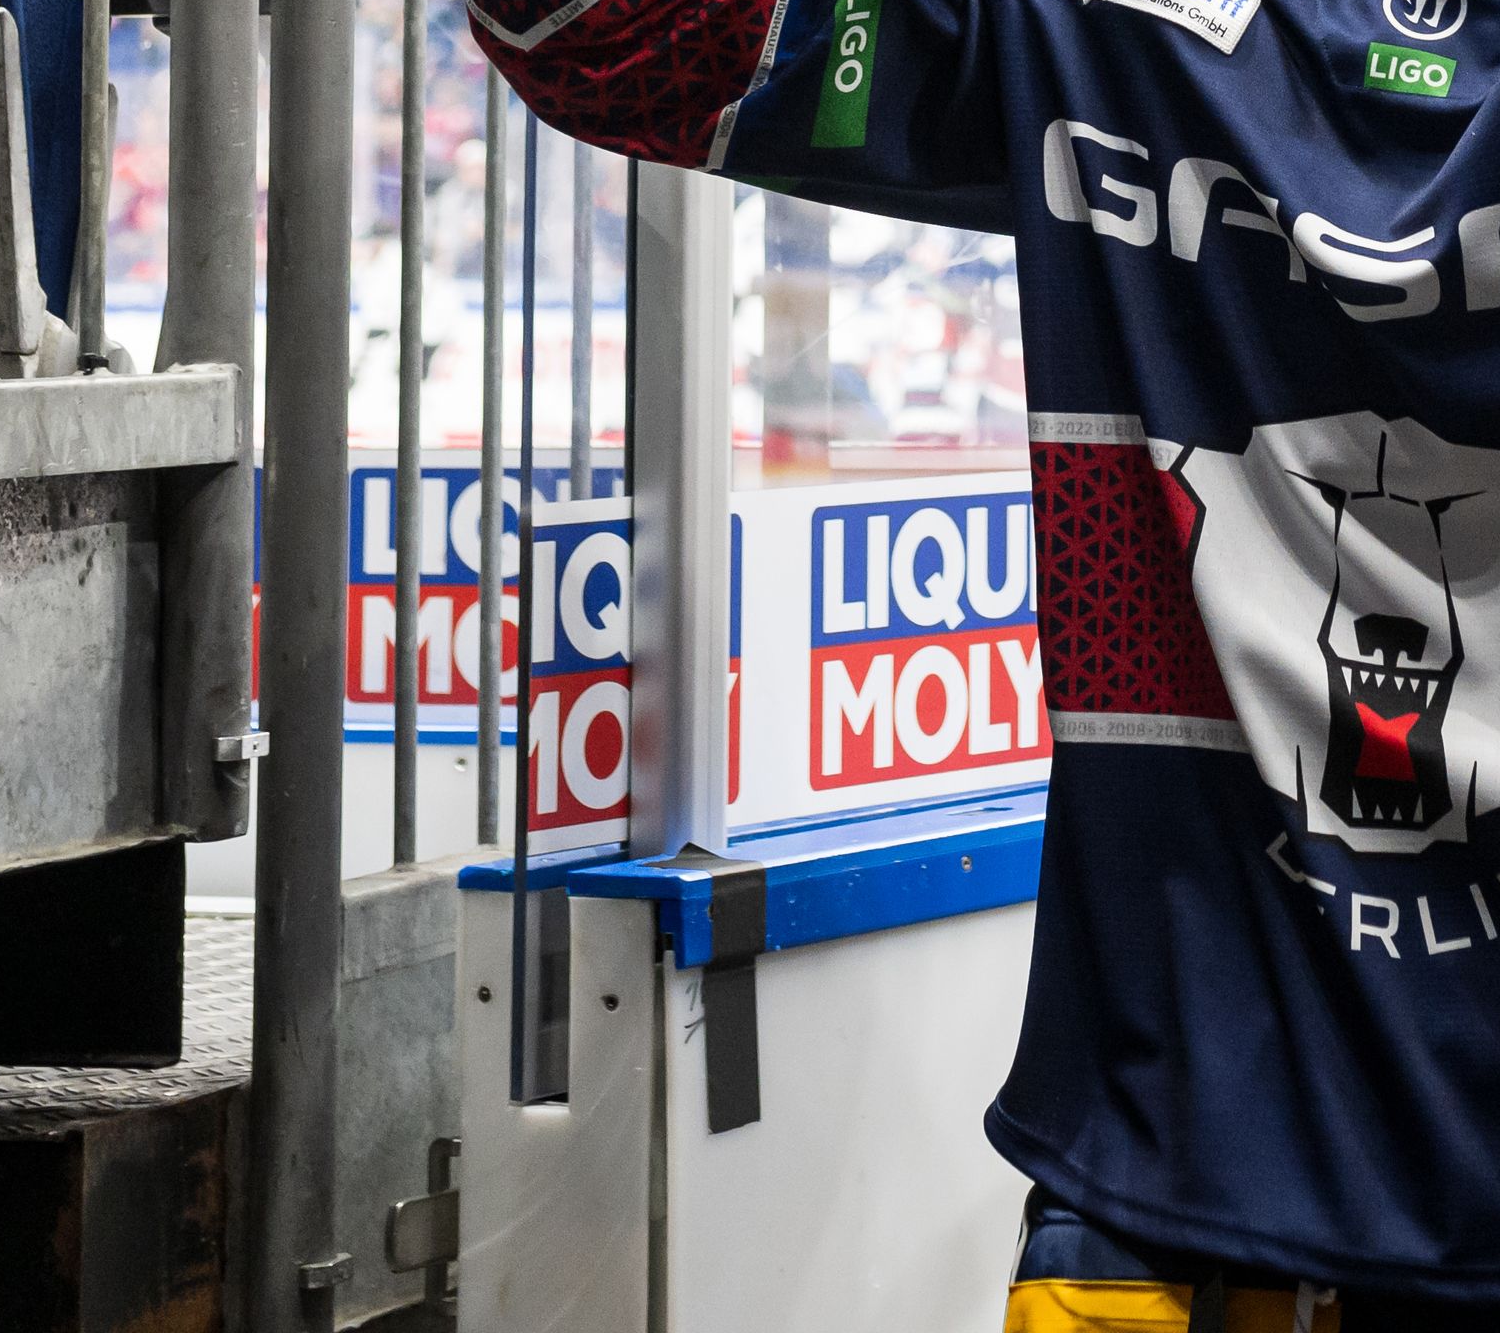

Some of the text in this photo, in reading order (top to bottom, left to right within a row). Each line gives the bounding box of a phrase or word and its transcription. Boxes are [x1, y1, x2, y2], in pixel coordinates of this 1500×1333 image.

[551, 0, 585, 28] MITTE
[1187, 7, 1229, 39] GmbH
[1369, 51, 1449, 89] LIGO
[821, 638, 1044, 777] MOLY
